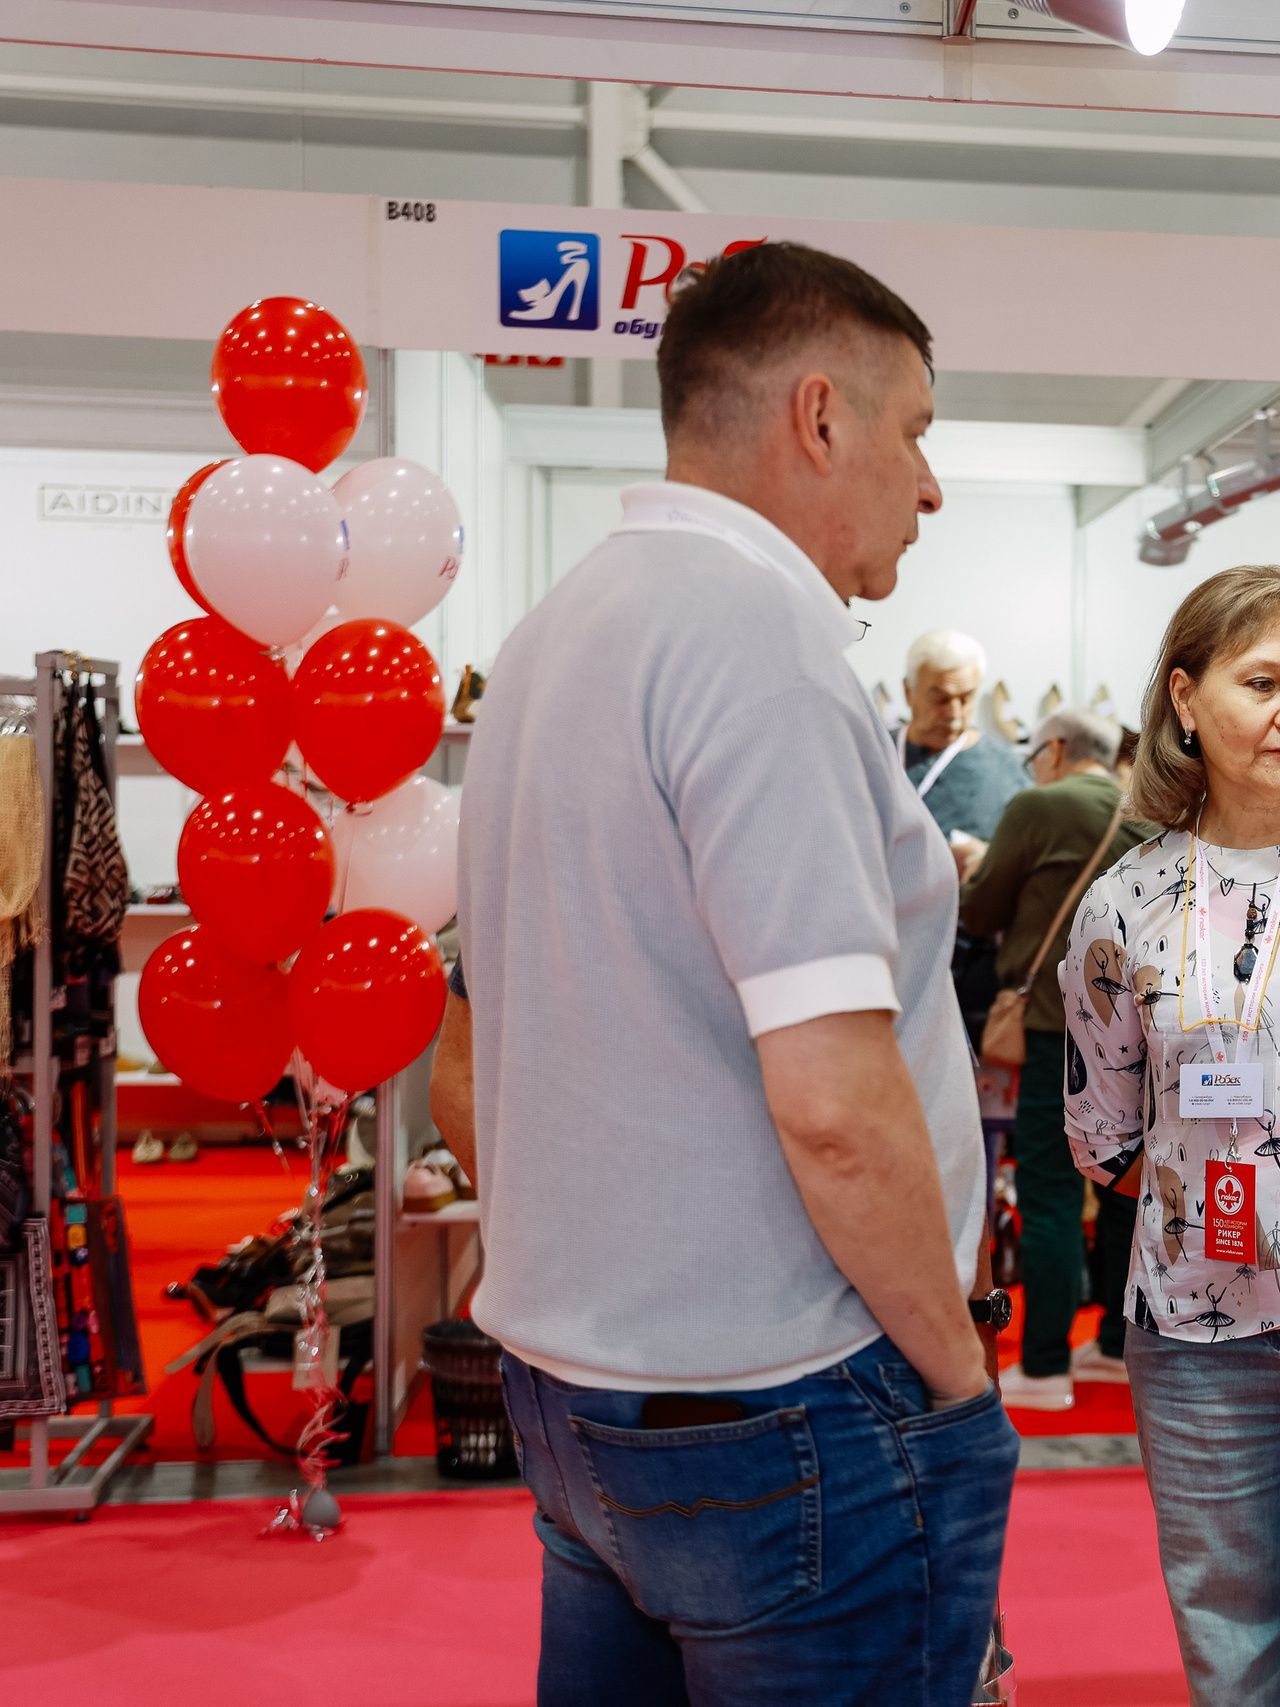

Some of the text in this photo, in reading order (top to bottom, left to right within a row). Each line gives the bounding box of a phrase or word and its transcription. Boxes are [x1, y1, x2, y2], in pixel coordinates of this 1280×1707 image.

[387, 202, 437, 223] B408
[613, 318, 665, 340] обу
[48, 492, 176, 517] AIDIN
[1214, 1074, 1241, 1084] Робек
[1213, 1218, 1224, 1228] 150
[1217, 1229, 1241, 1239] РИКЕР
[1215, 1238, 1231, 1246] SINCE
